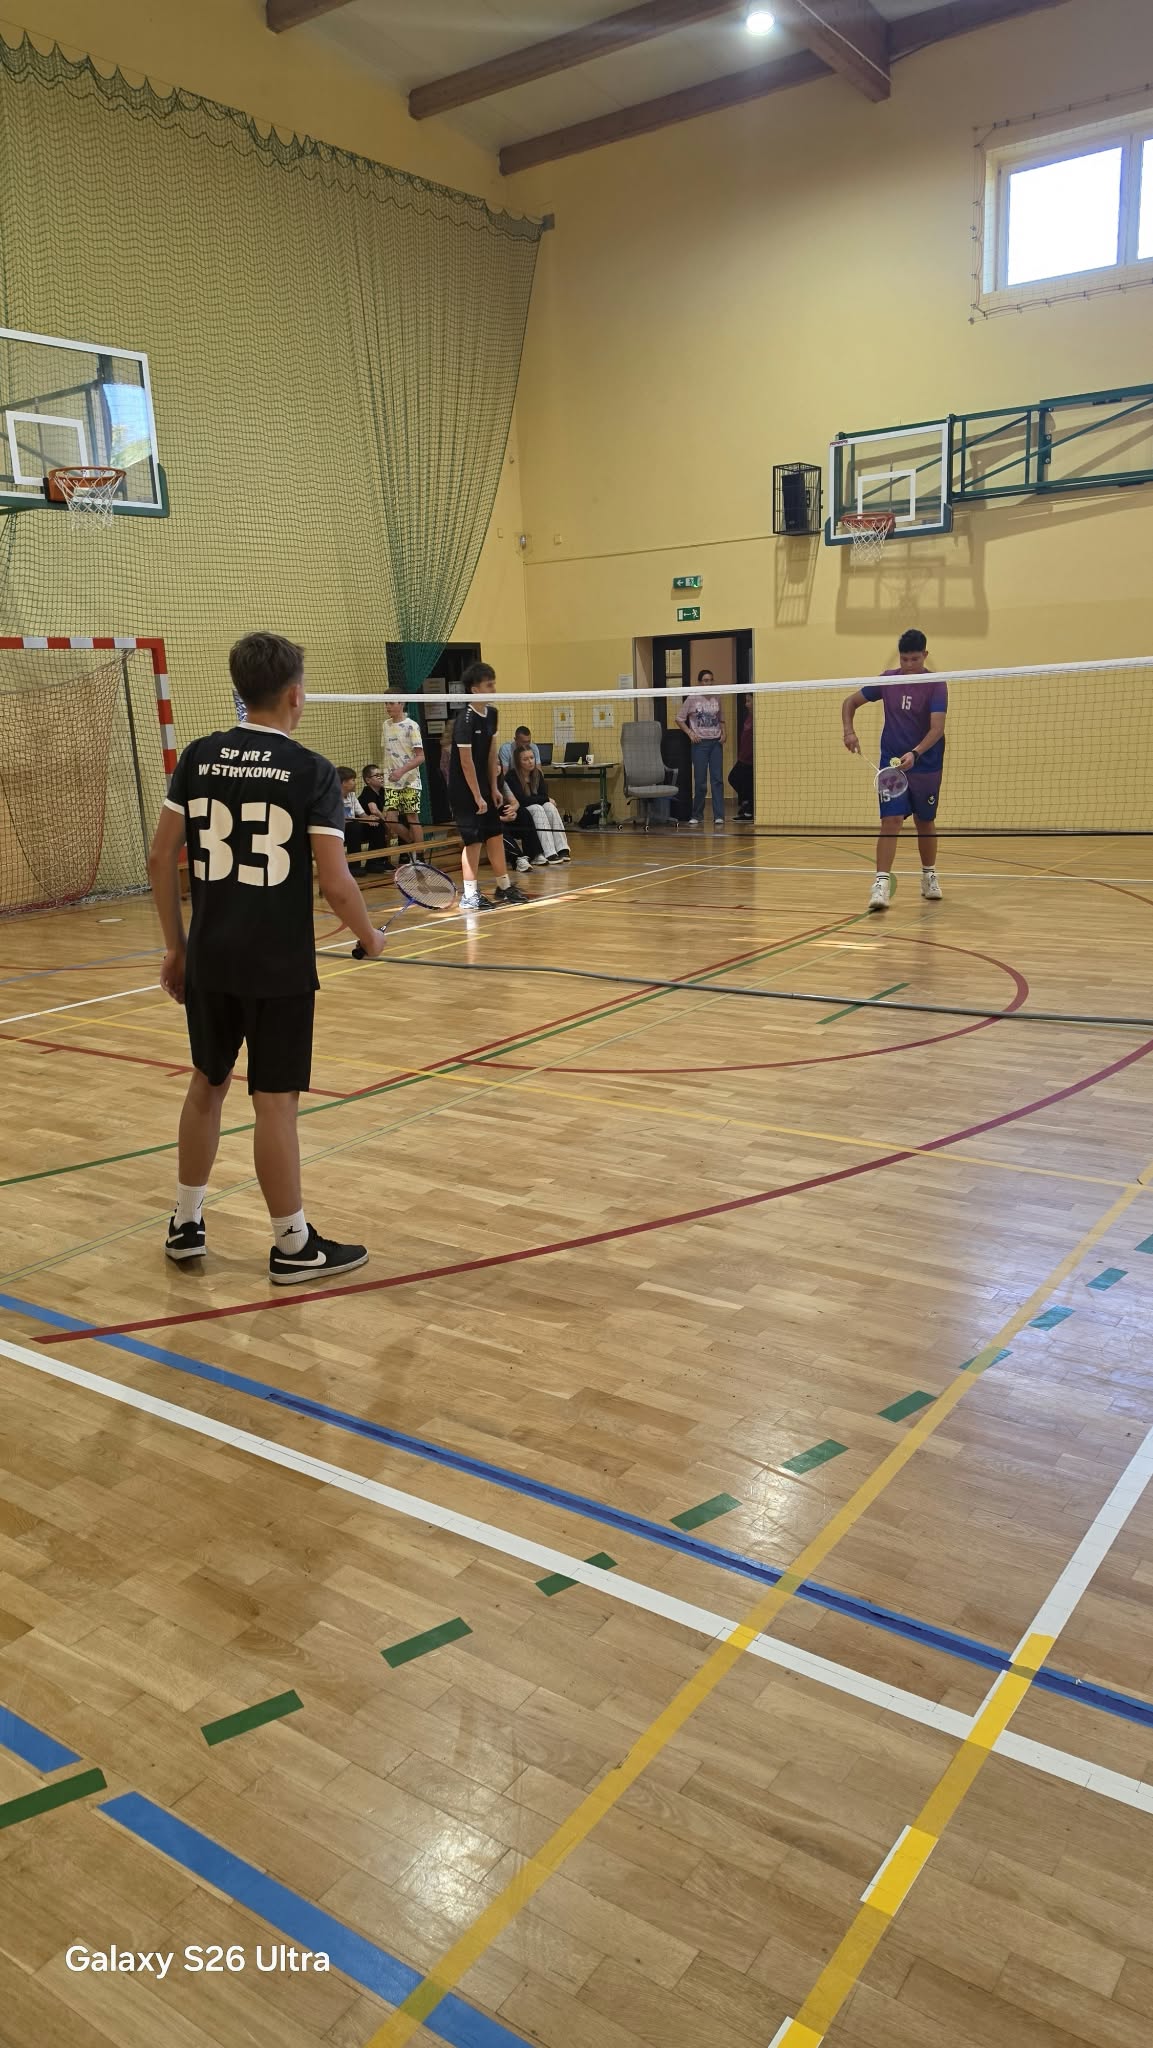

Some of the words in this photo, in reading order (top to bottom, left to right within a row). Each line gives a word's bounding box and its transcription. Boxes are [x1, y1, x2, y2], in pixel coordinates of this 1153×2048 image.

[901, 695, 913, 710] 15
[220, 747, 239, 760] SP
[241, 750, 260, 762] NR
[262, 750, 272, 762] 2
[198, 763, 210, 776] W
[211, 764, 291, 782] STRYKOWIE
[187, 797, 294, 887] 33
